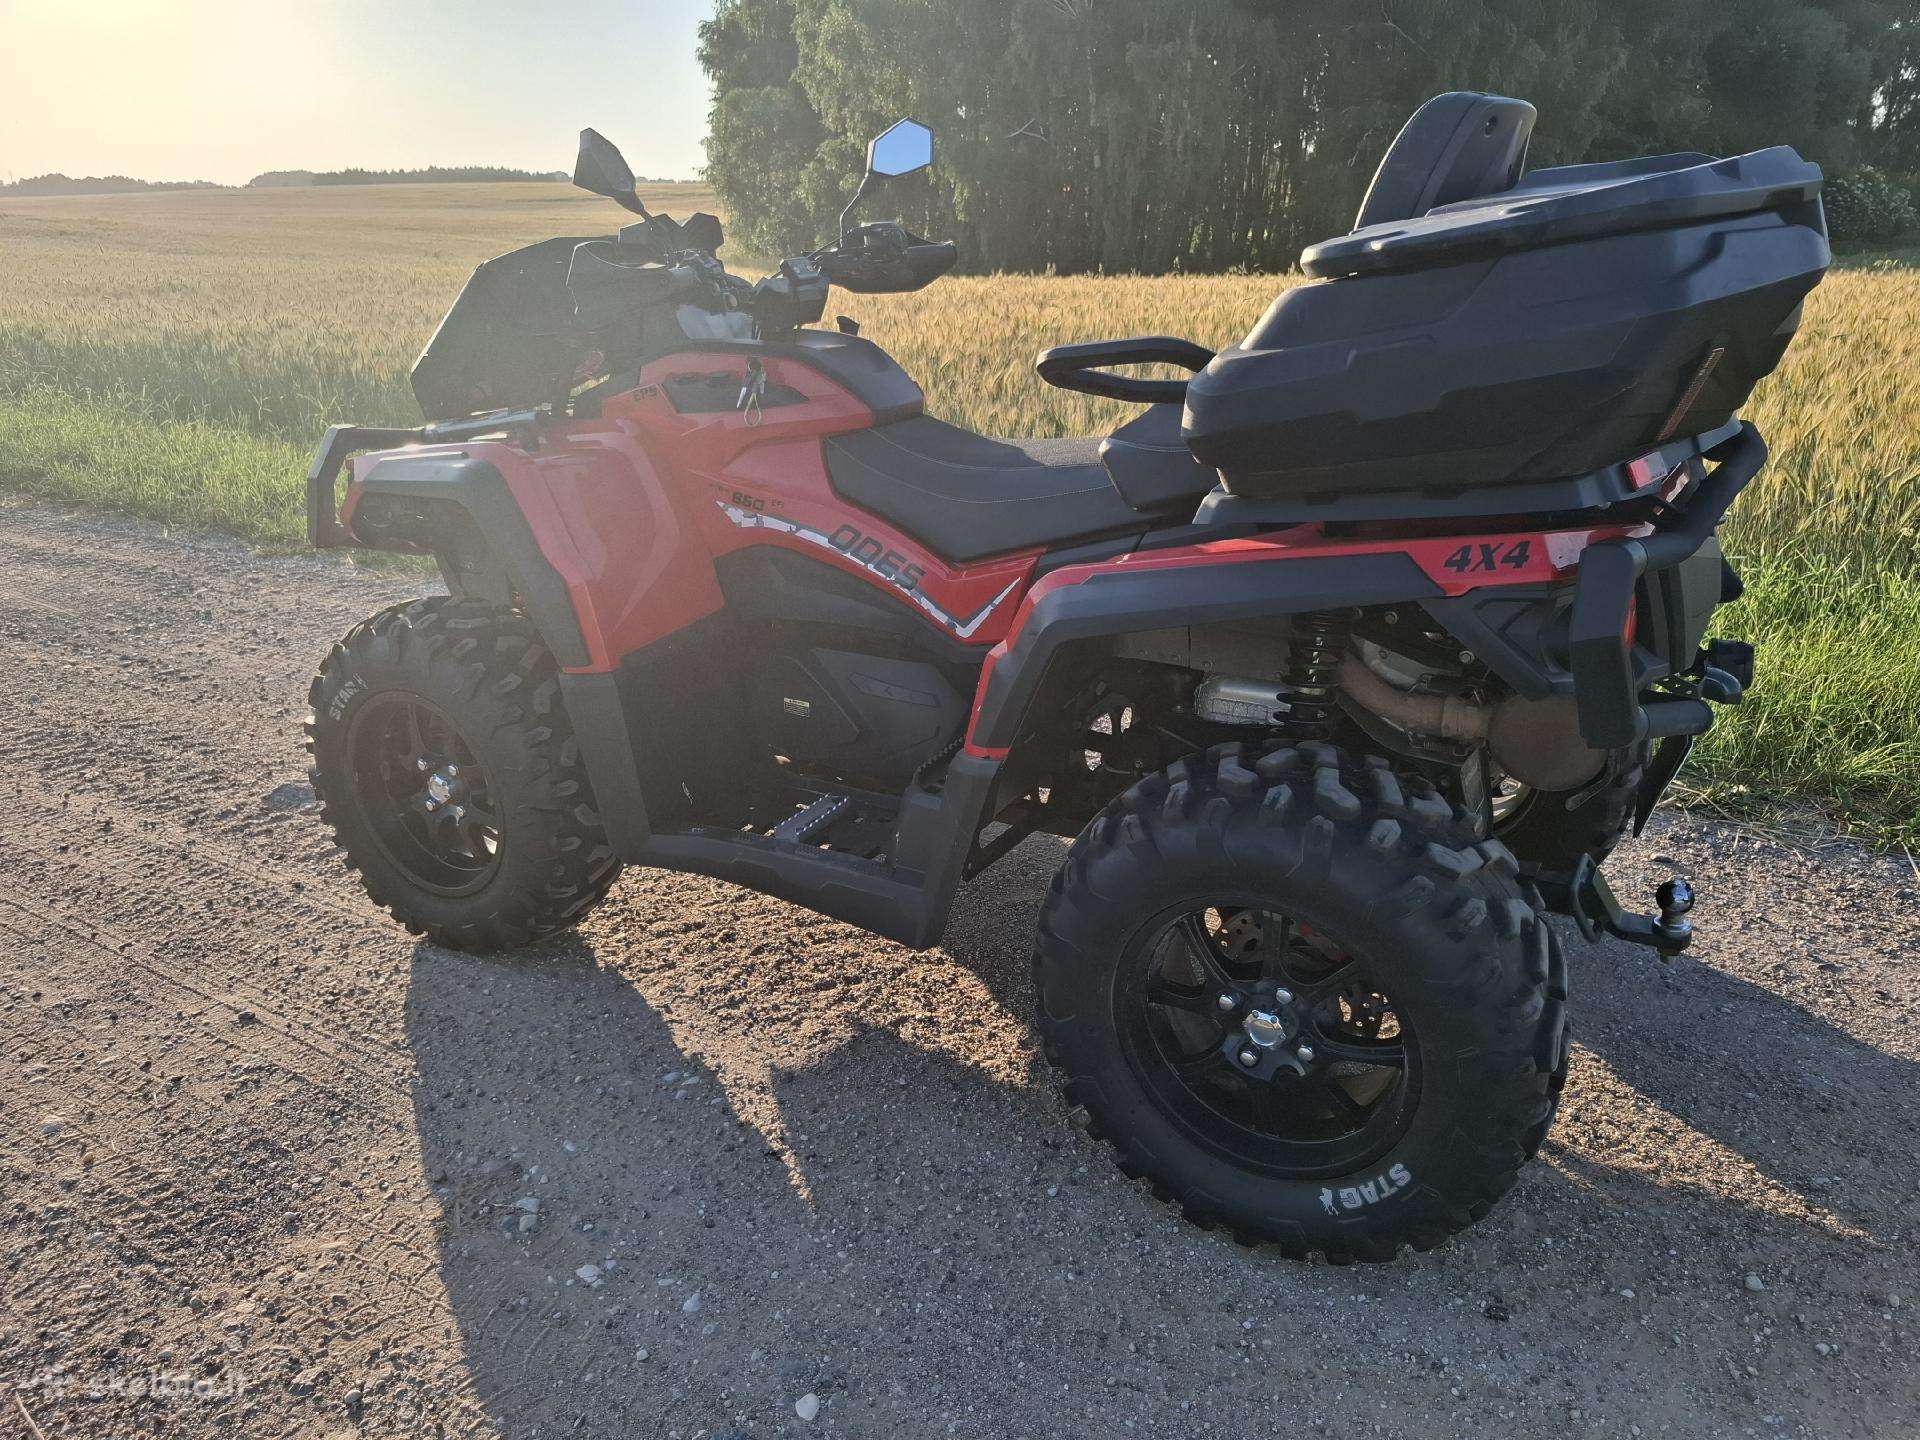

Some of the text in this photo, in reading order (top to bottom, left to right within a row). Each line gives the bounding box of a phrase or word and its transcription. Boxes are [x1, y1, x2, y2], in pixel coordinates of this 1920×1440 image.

[828, 523, 928, 591] ODES
[1443, 540, 1531, 573] 4X4
[1339, 1161, 1412, 1209] STAG
